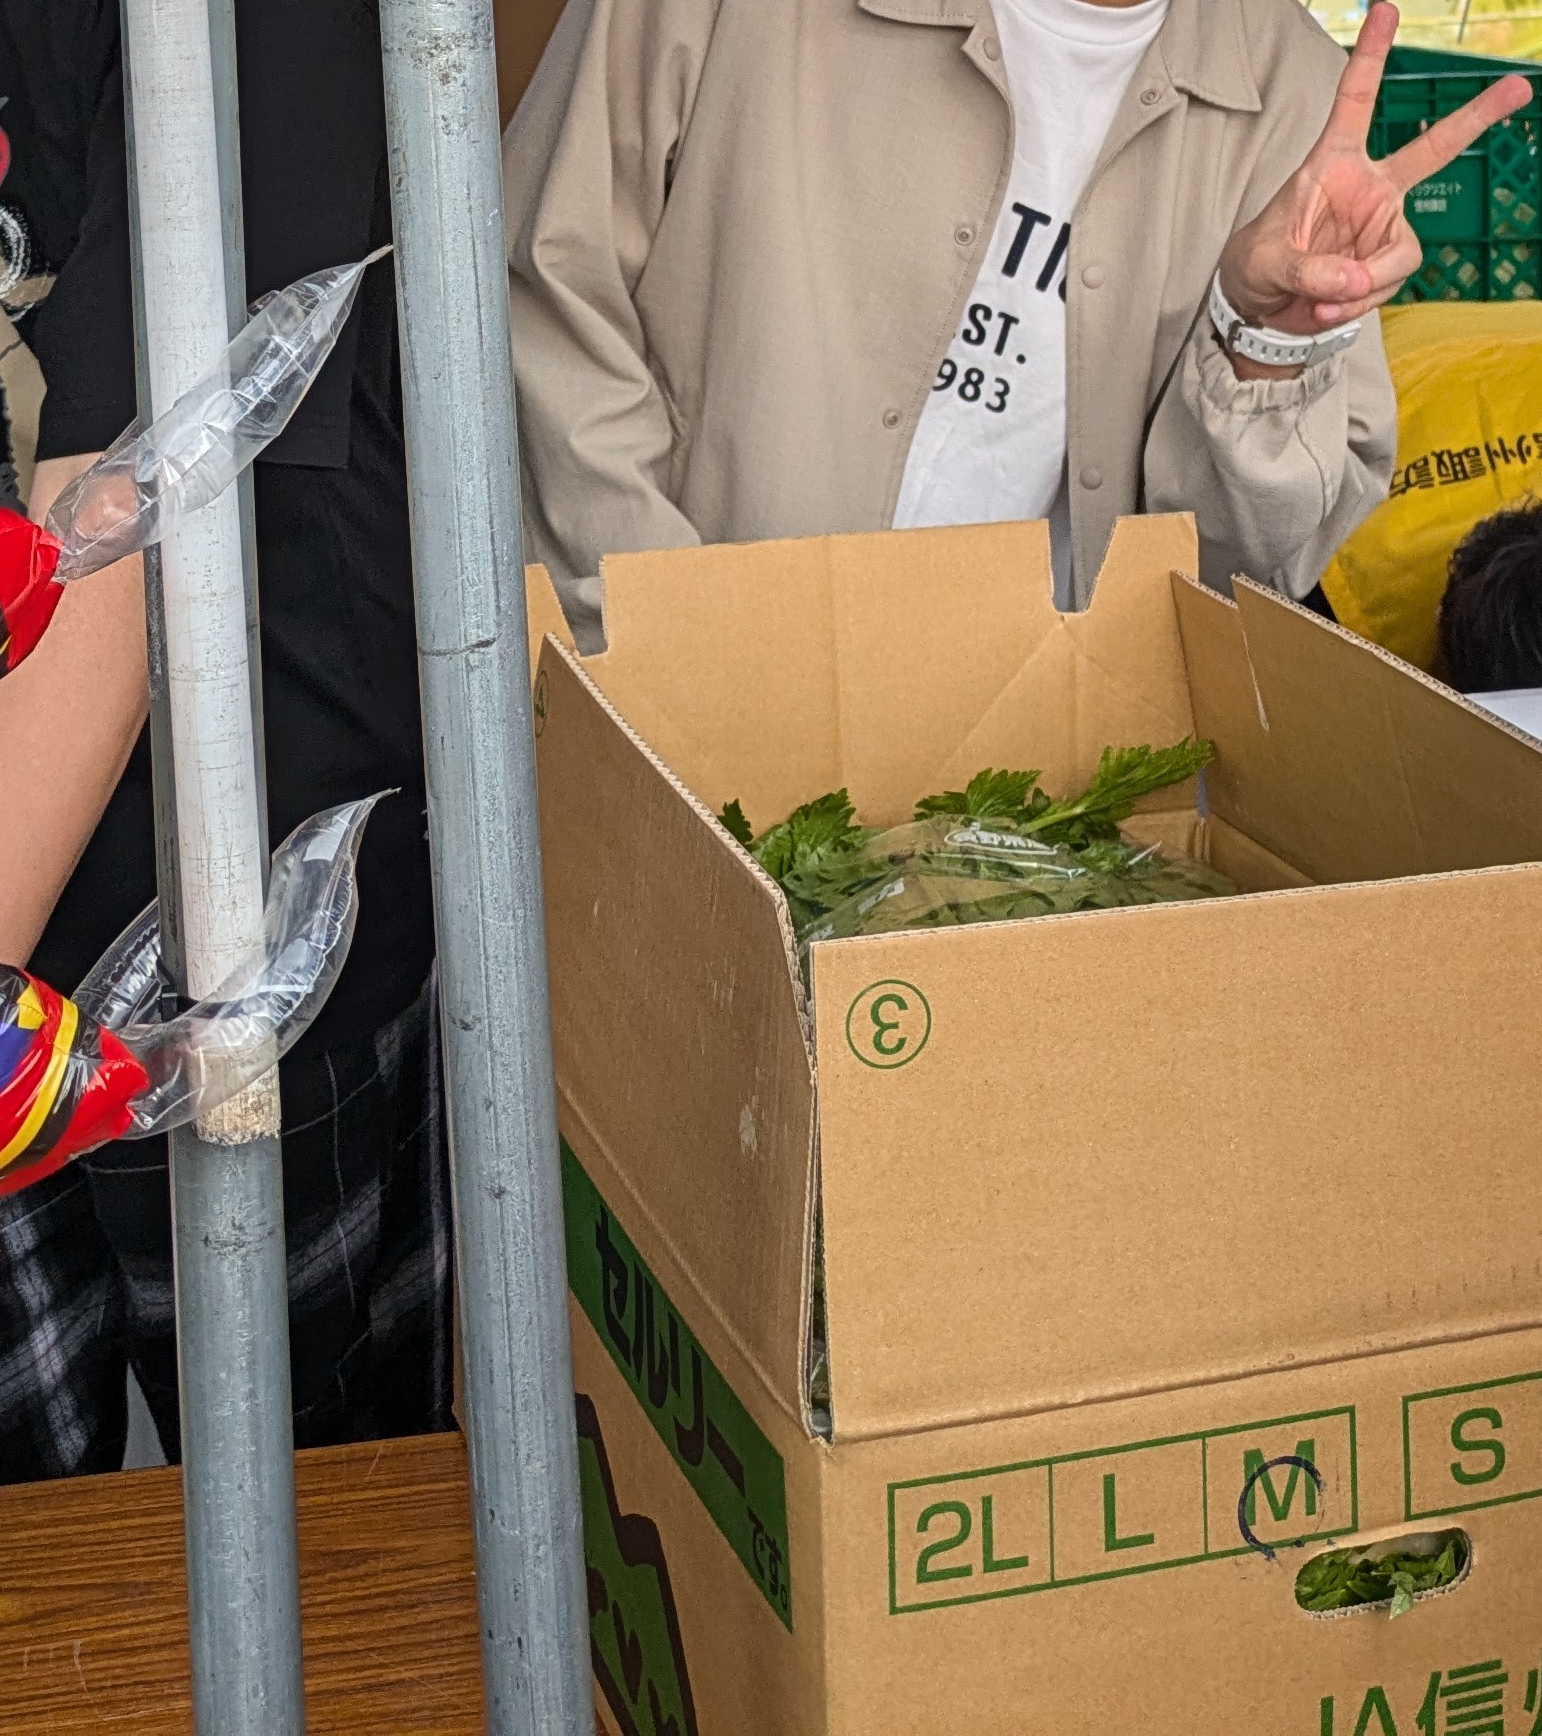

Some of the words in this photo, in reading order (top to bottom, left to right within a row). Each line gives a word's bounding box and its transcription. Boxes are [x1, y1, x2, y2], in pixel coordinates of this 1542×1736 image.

[1001, 201, 1072, 304] TI
[953, 302, 1027, 365] ST.
[914, 1493, 1031, 1587] 2L
[1102, 1471, 1156, 1554] L
[1243, 1438, 1320, 1527] M
[1449, 1406, 1506, 1487] S
